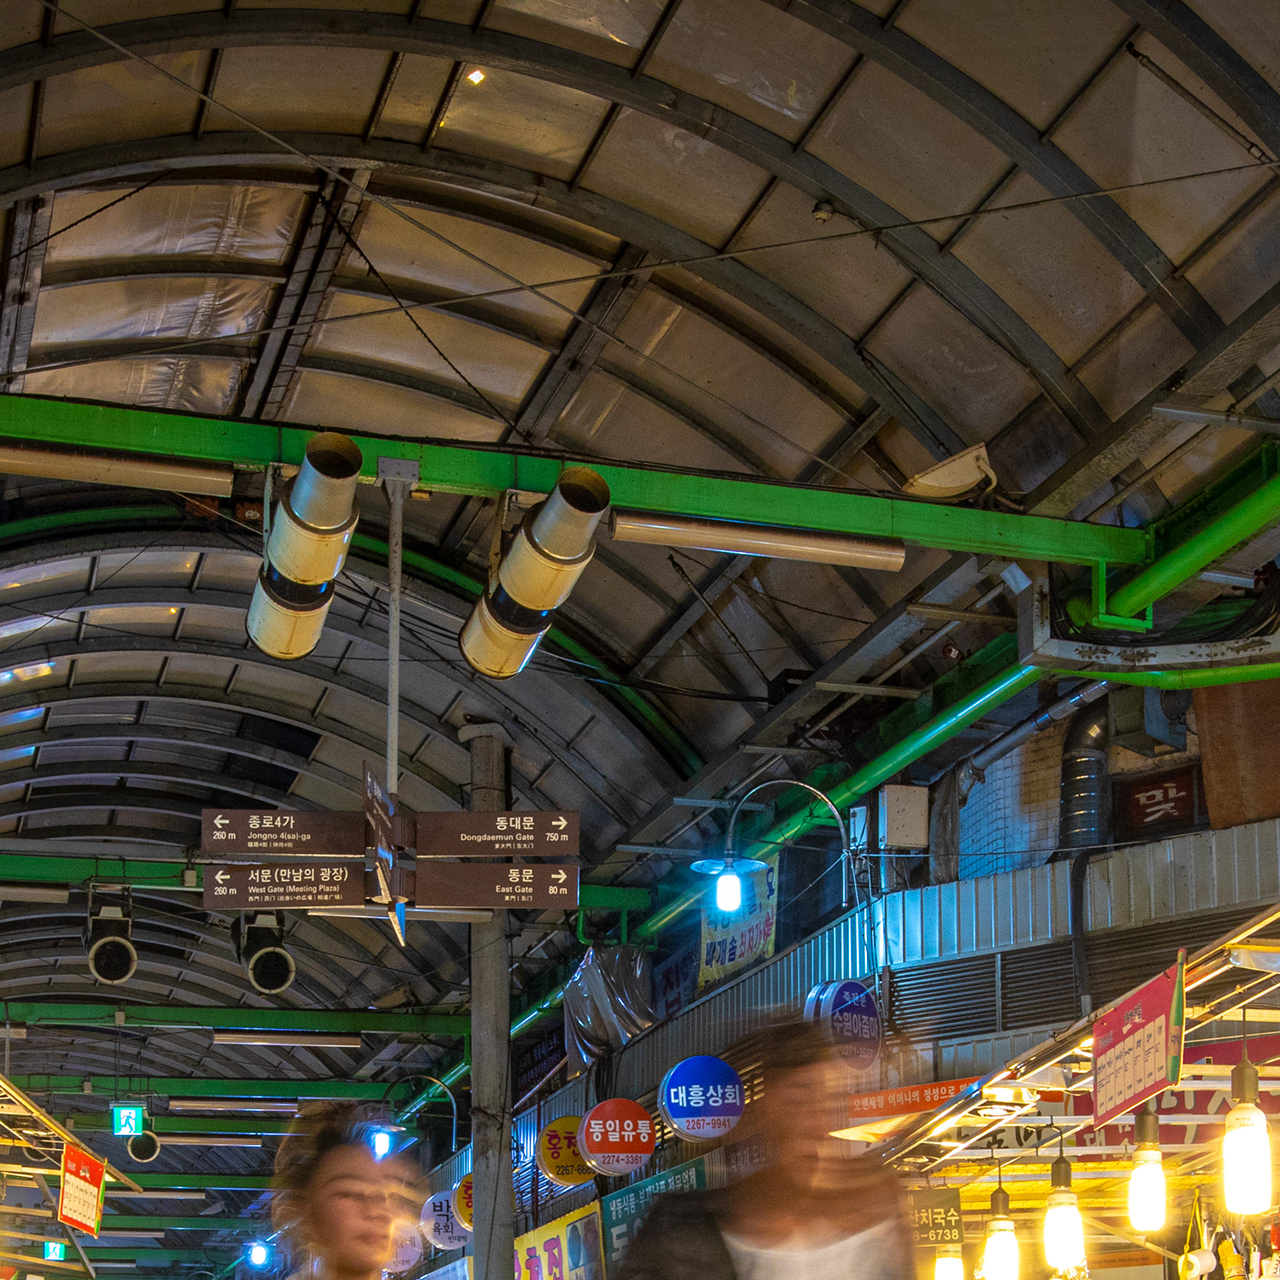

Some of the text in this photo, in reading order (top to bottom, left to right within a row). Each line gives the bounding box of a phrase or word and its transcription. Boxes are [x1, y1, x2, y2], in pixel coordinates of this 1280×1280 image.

[248, 815, 295, 829] 종로4가
[496, 816, 535, 831] 동대문
[213, 831, 227, 840] 260
[248, 832, 311, 841] Jongno 4(sa)-ga
[460, 833, 535, 843] Dongdaemun Gate
[546, 833, 569, 842] 750 m
[248, 866, 349, 883] 서문 (만남의 광장)
[509, 869, 534, 884] 동문
[214, 887, 238, 896] 260 m
[248, 884, 340, 896] West Gate (Meeting Plaza)
[495, 885, 534, 894] East Gate
[548, 886, 558, 895] 80
[670, 1084, 740, 1108] 대흥상회
[888, 1089, 920, 1106] 어머니의
[922, 1085, 956, 1102] 정성으로
[685, 1117, 731, 1131] 2267-9941
[589, 1119, 652, 1143] 동일유통
[601, 1154, 643, 1166] 2274-3361
[432, 1222, 454, 1235] 육회
